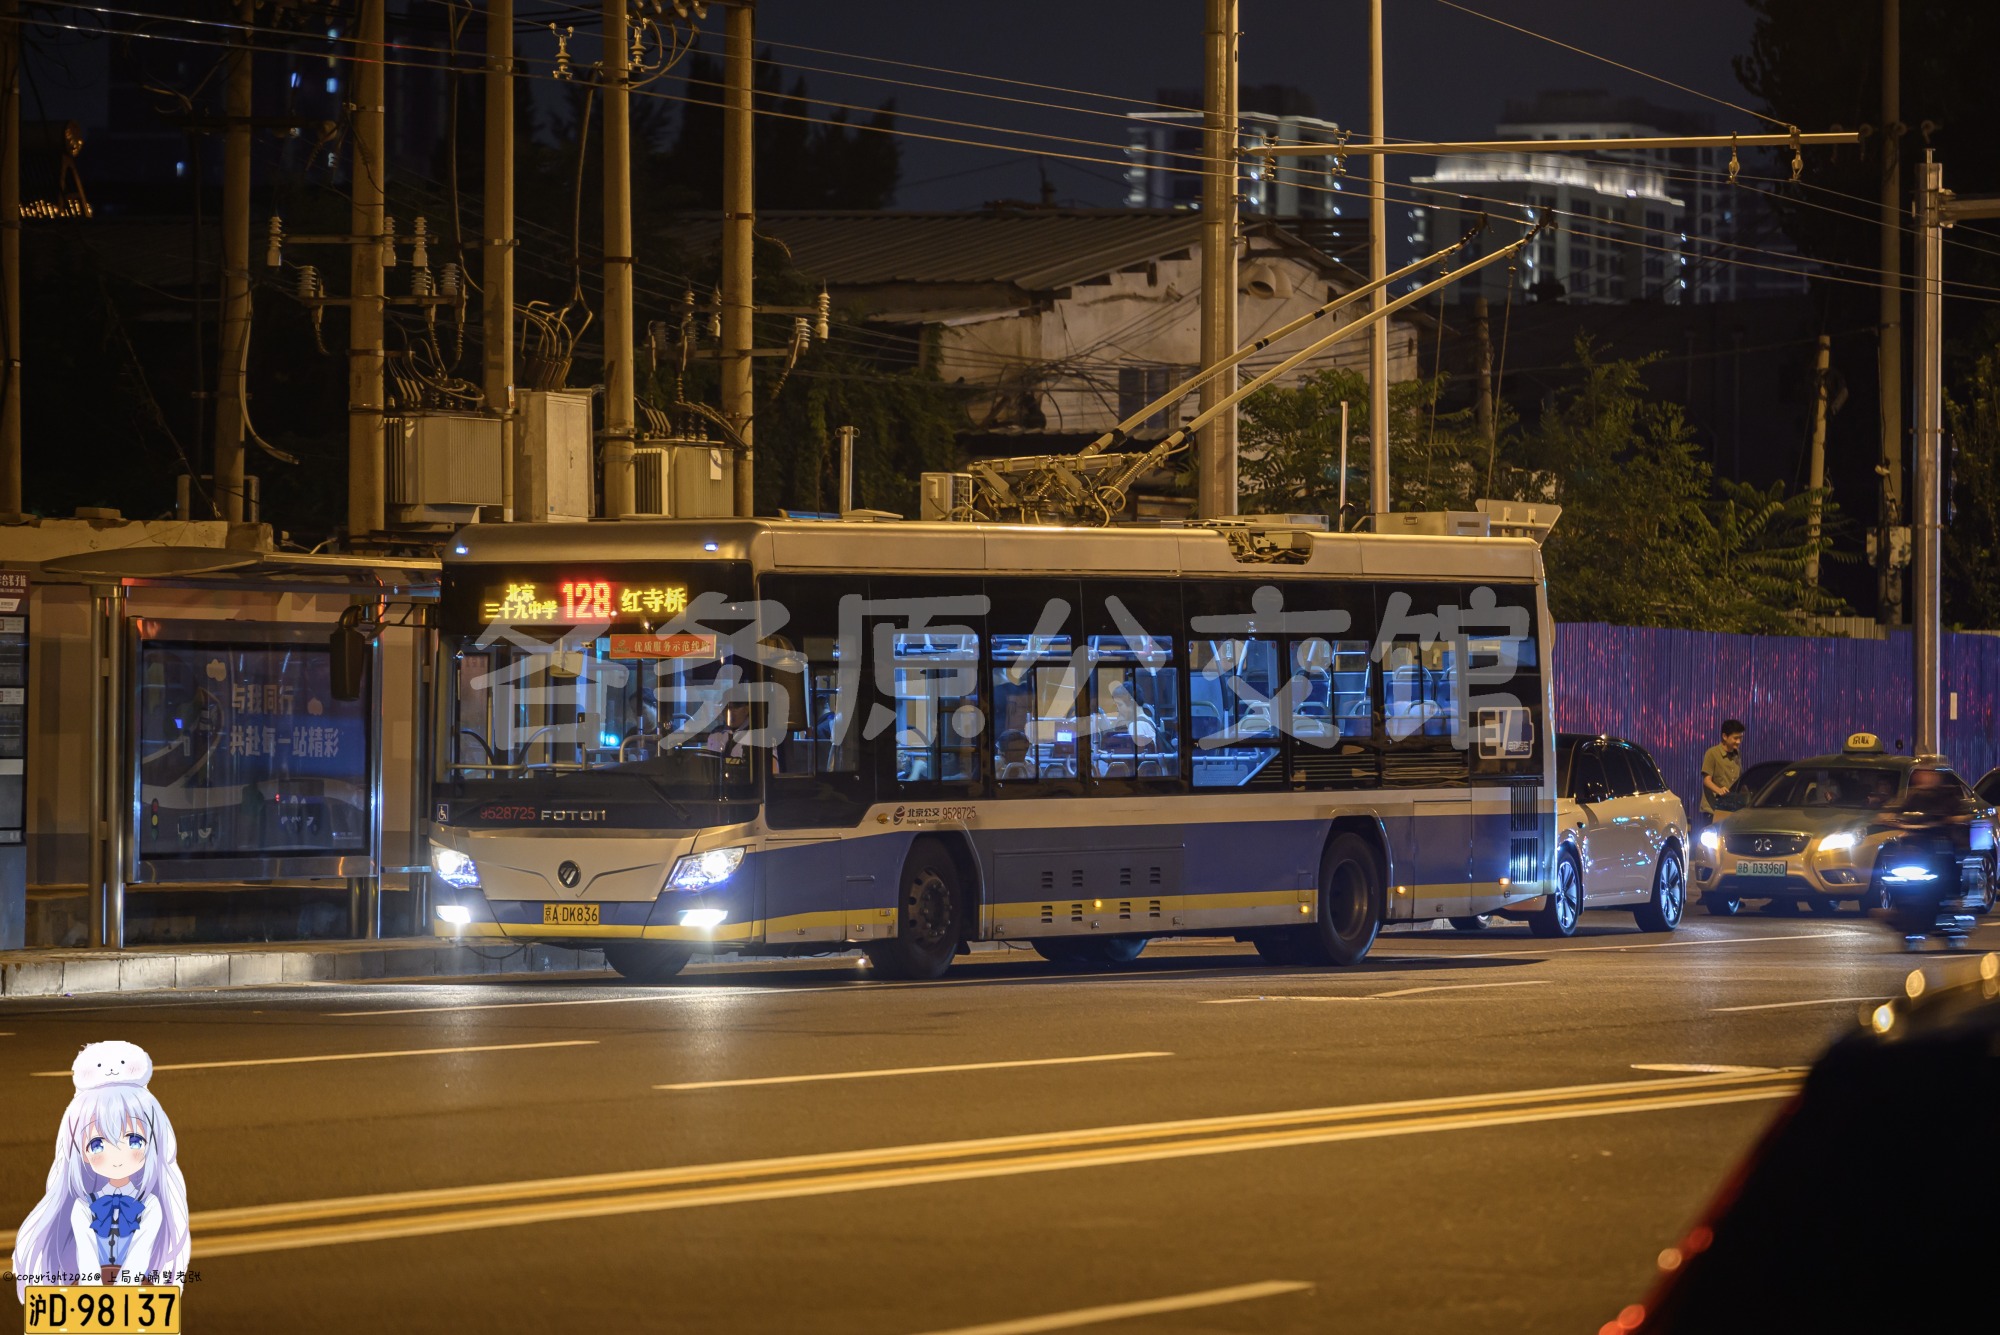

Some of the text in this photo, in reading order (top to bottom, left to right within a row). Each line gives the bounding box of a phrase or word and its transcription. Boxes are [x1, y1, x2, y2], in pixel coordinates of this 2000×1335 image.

[505, 584, 535, 602] 北京
[562, 583, 611, 618] 128
[621, 587, 687, 613] 红寺桥
[485, 600, 558, 619] 三十九中学
[634, 641, 711, 652] 优质服务示范线路
[232, 684, 293, 714] 与我同行
[230, 726, 339, 757] 共赴每一站精彩
[480, 807, 536, 819] 9528725
[541, 810, 606, 820] FOTON
[907, 808, 940, 818] 北京公交
[942, 806, 976, 820] 9528725
